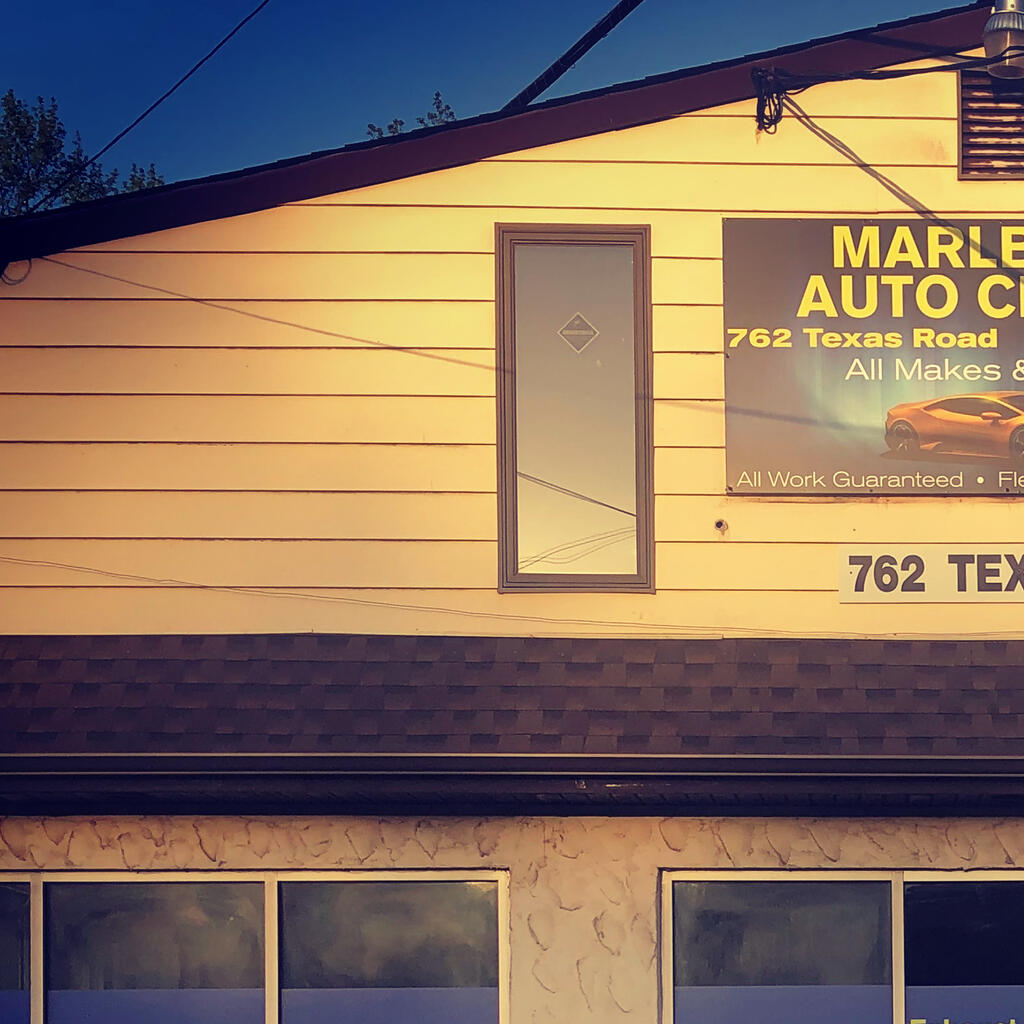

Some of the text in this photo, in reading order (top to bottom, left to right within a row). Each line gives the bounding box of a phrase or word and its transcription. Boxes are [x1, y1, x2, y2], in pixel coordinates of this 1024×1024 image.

[796, 274, 959, 319] AUTO
[727, 328, 793, 348] 762
[802, 327, 903, 349] Texas
[913, 328, 998, 349] Road
[844, 358, 883, 381] All
[895, 358, 1002, 382] Makes
[736, 470, 762, 488] All
[767, 470, 827, 488] Work
[832, 470, 963, 488] Guaranteed
[848, 554, 926, 593] 762
